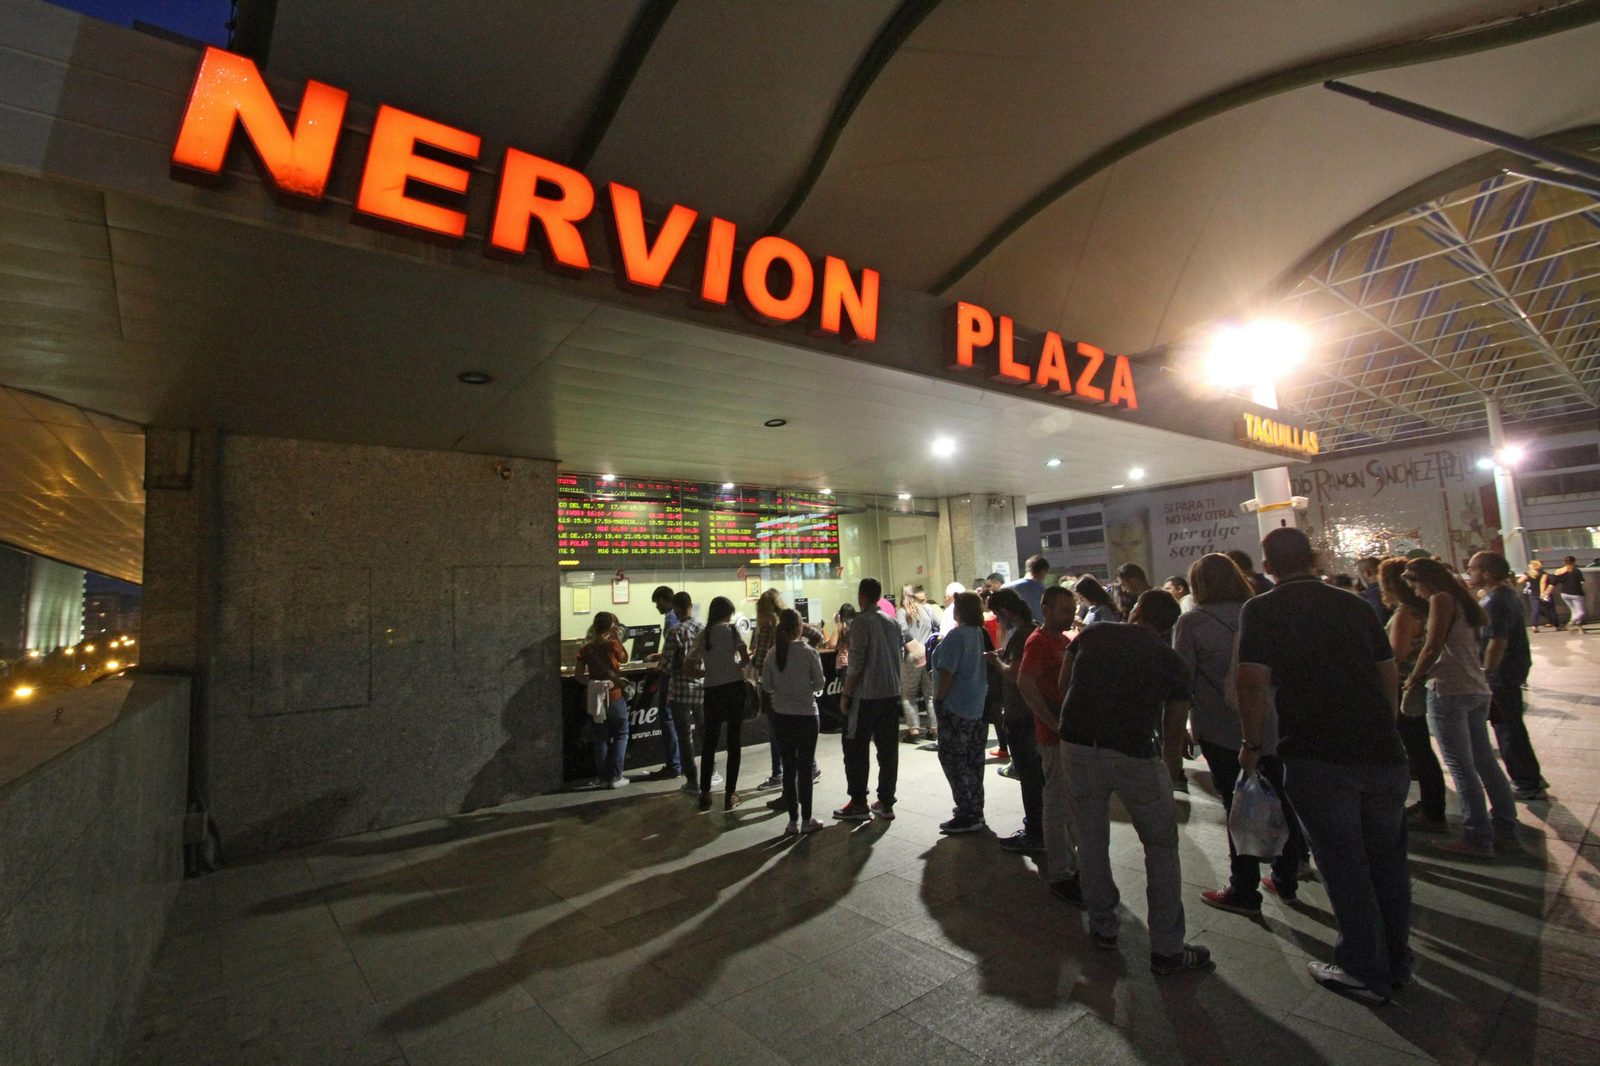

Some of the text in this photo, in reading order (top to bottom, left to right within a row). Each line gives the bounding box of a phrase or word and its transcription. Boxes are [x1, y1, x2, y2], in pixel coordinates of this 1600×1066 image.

[172, 46, 1138, 410] NERVION PLAZA
[1243, 412, 1319, 455] TAQUILLAS
[1164, 498, 1215, 513] SI PARA TI
[1166, 515, 1181, 525] NO
[1183, 512, 1203, 523] HAY
[1168, 522, 1240, 545] por algo
[614, 568, 625, 582] 5
[835, 566, 844, 577] 7
